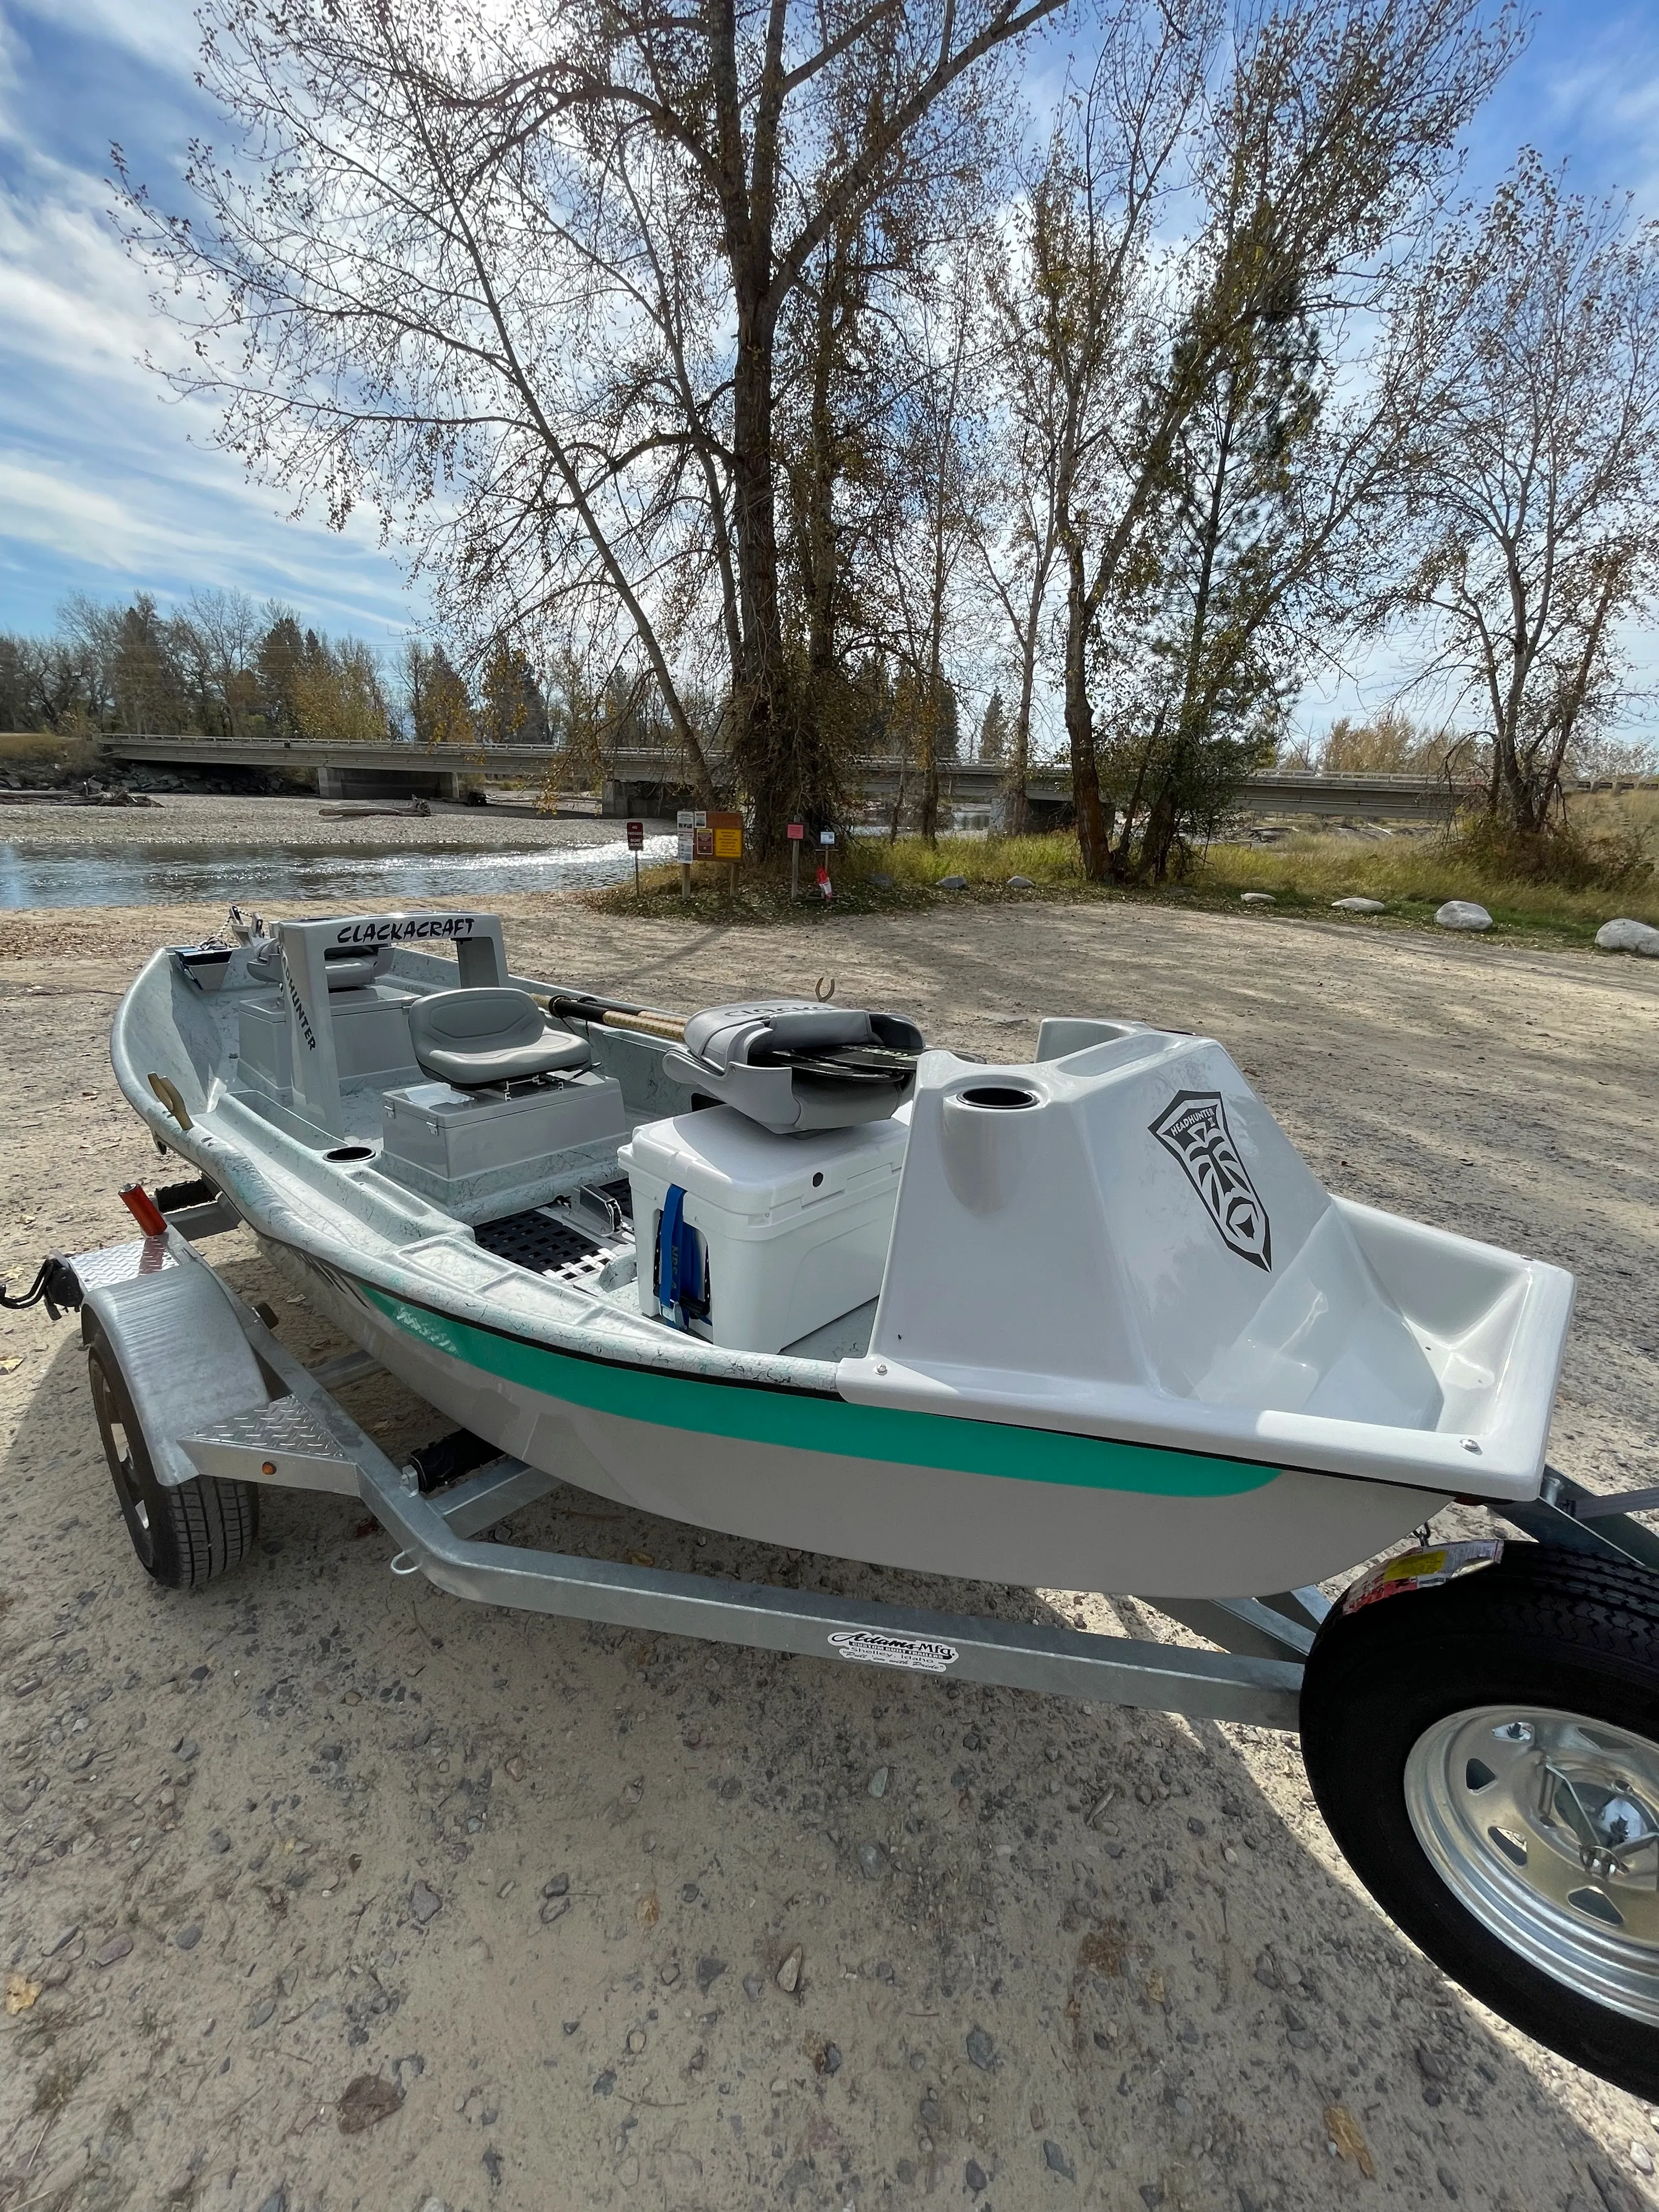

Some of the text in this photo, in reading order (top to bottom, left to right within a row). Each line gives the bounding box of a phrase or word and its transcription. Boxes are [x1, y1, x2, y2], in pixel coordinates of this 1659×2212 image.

[337, 918, 475, 943] CLACKACRAFT
[1171, 1108, 1215, 1136] HEADHUNTER
[832, 1634, 955, 1660] Adams Mfg.
[901, 1654, 934, 1663] Idaho
